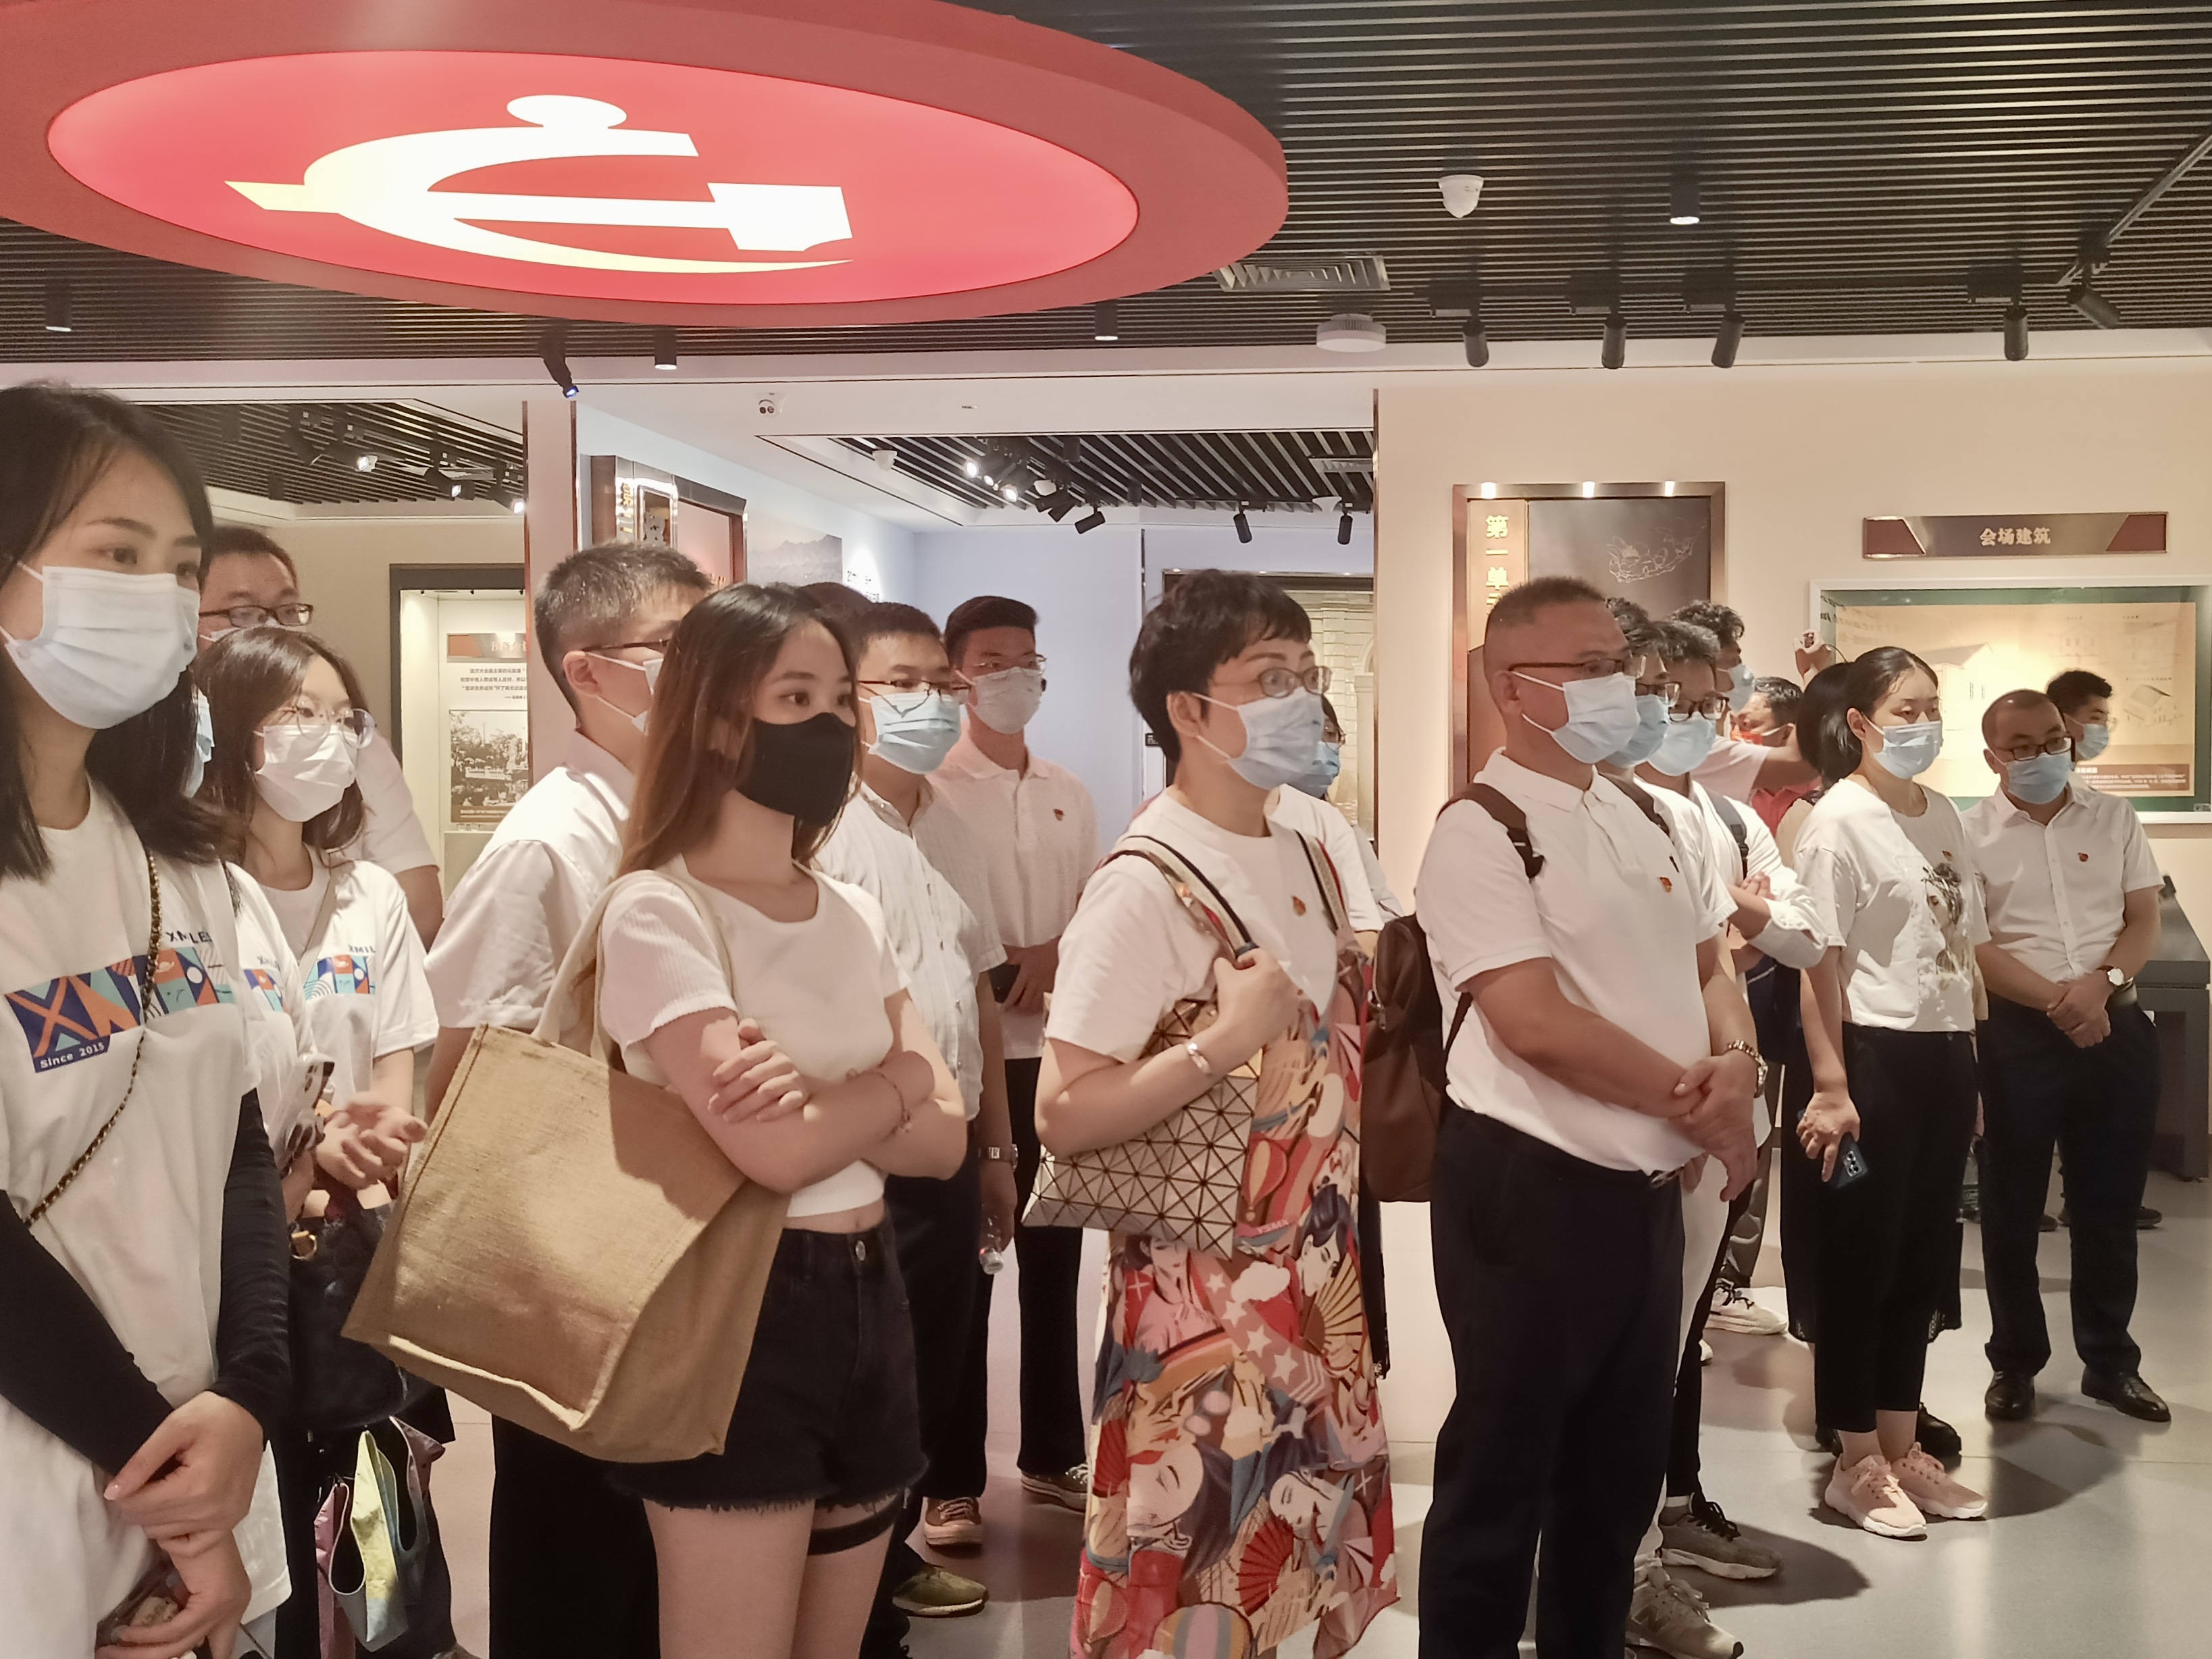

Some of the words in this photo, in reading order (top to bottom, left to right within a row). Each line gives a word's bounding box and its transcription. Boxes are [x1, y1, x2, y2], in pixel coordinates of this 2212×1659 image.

[1979, 527, 2051, 546] 会场建筑
[39, 1053, 74, 1069] Since
